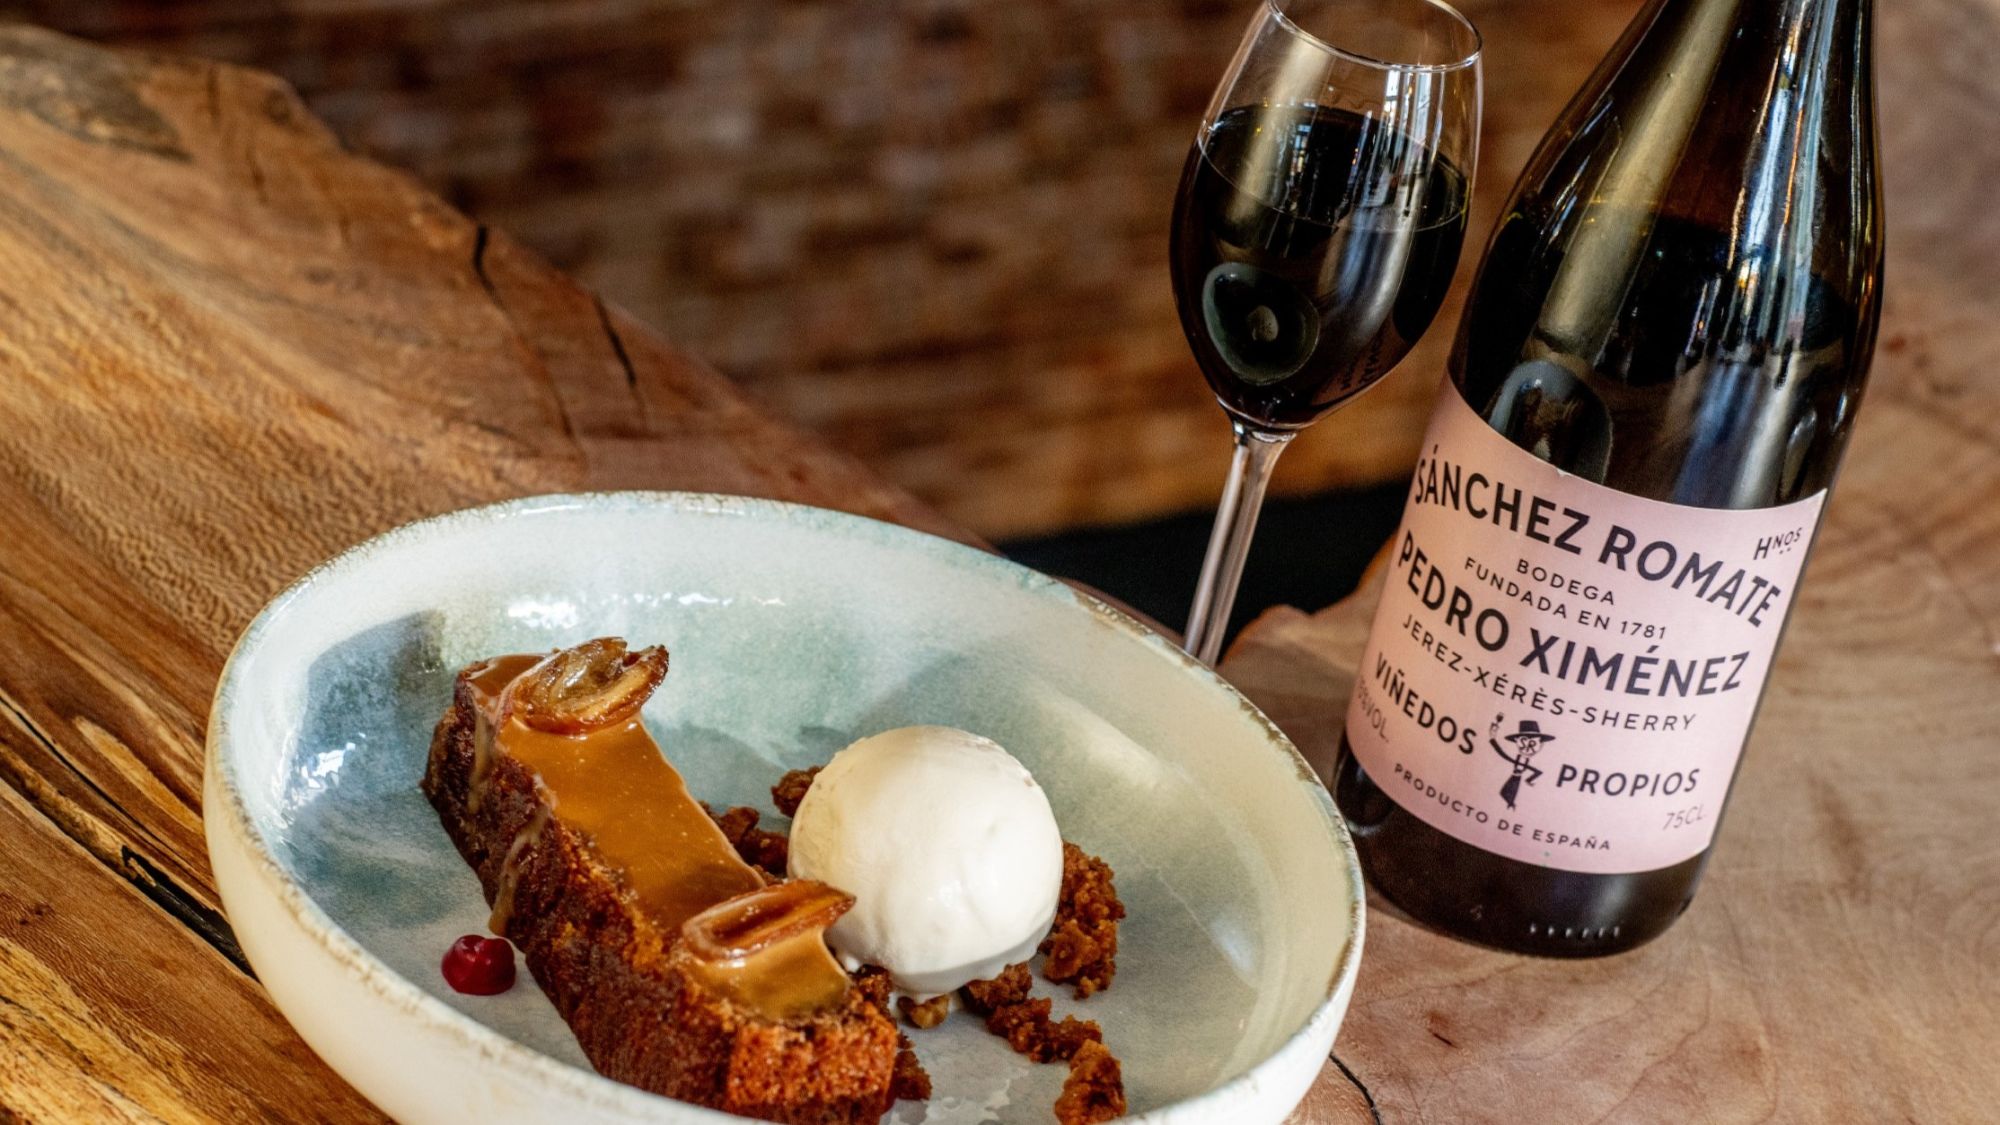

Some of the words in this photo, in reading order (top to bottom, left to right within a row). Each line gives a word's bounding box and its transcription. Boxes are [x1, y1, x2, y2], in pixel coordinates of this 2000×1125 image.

[1414, 444, 1591, 556] SÁNCHEZ
[1597, 524, 1782, 629] ROMATE
[1398, 529, 1510, 653] PEDRO
[1519, 626, 1750, 698] XIMÉNEZ
[1464, 556, 1568, 620] FUNDADA
[1577, 609, 1611, 631] EN
[1619, 620, 1667, 641] 1781
[1515, 558, 1615, 606] BODEGA
[1375, 652, 1478, 756] VIÑEDOS
[1555, 763, 1701, 798] PROPIOS
[1519, 736, 1537, 754] SR
[1393, 762, 1489, 825] PRODUCTO
[1497, 818, 1524, 837] DE
[1531, 828, 1611, 852] ESPAÑA
